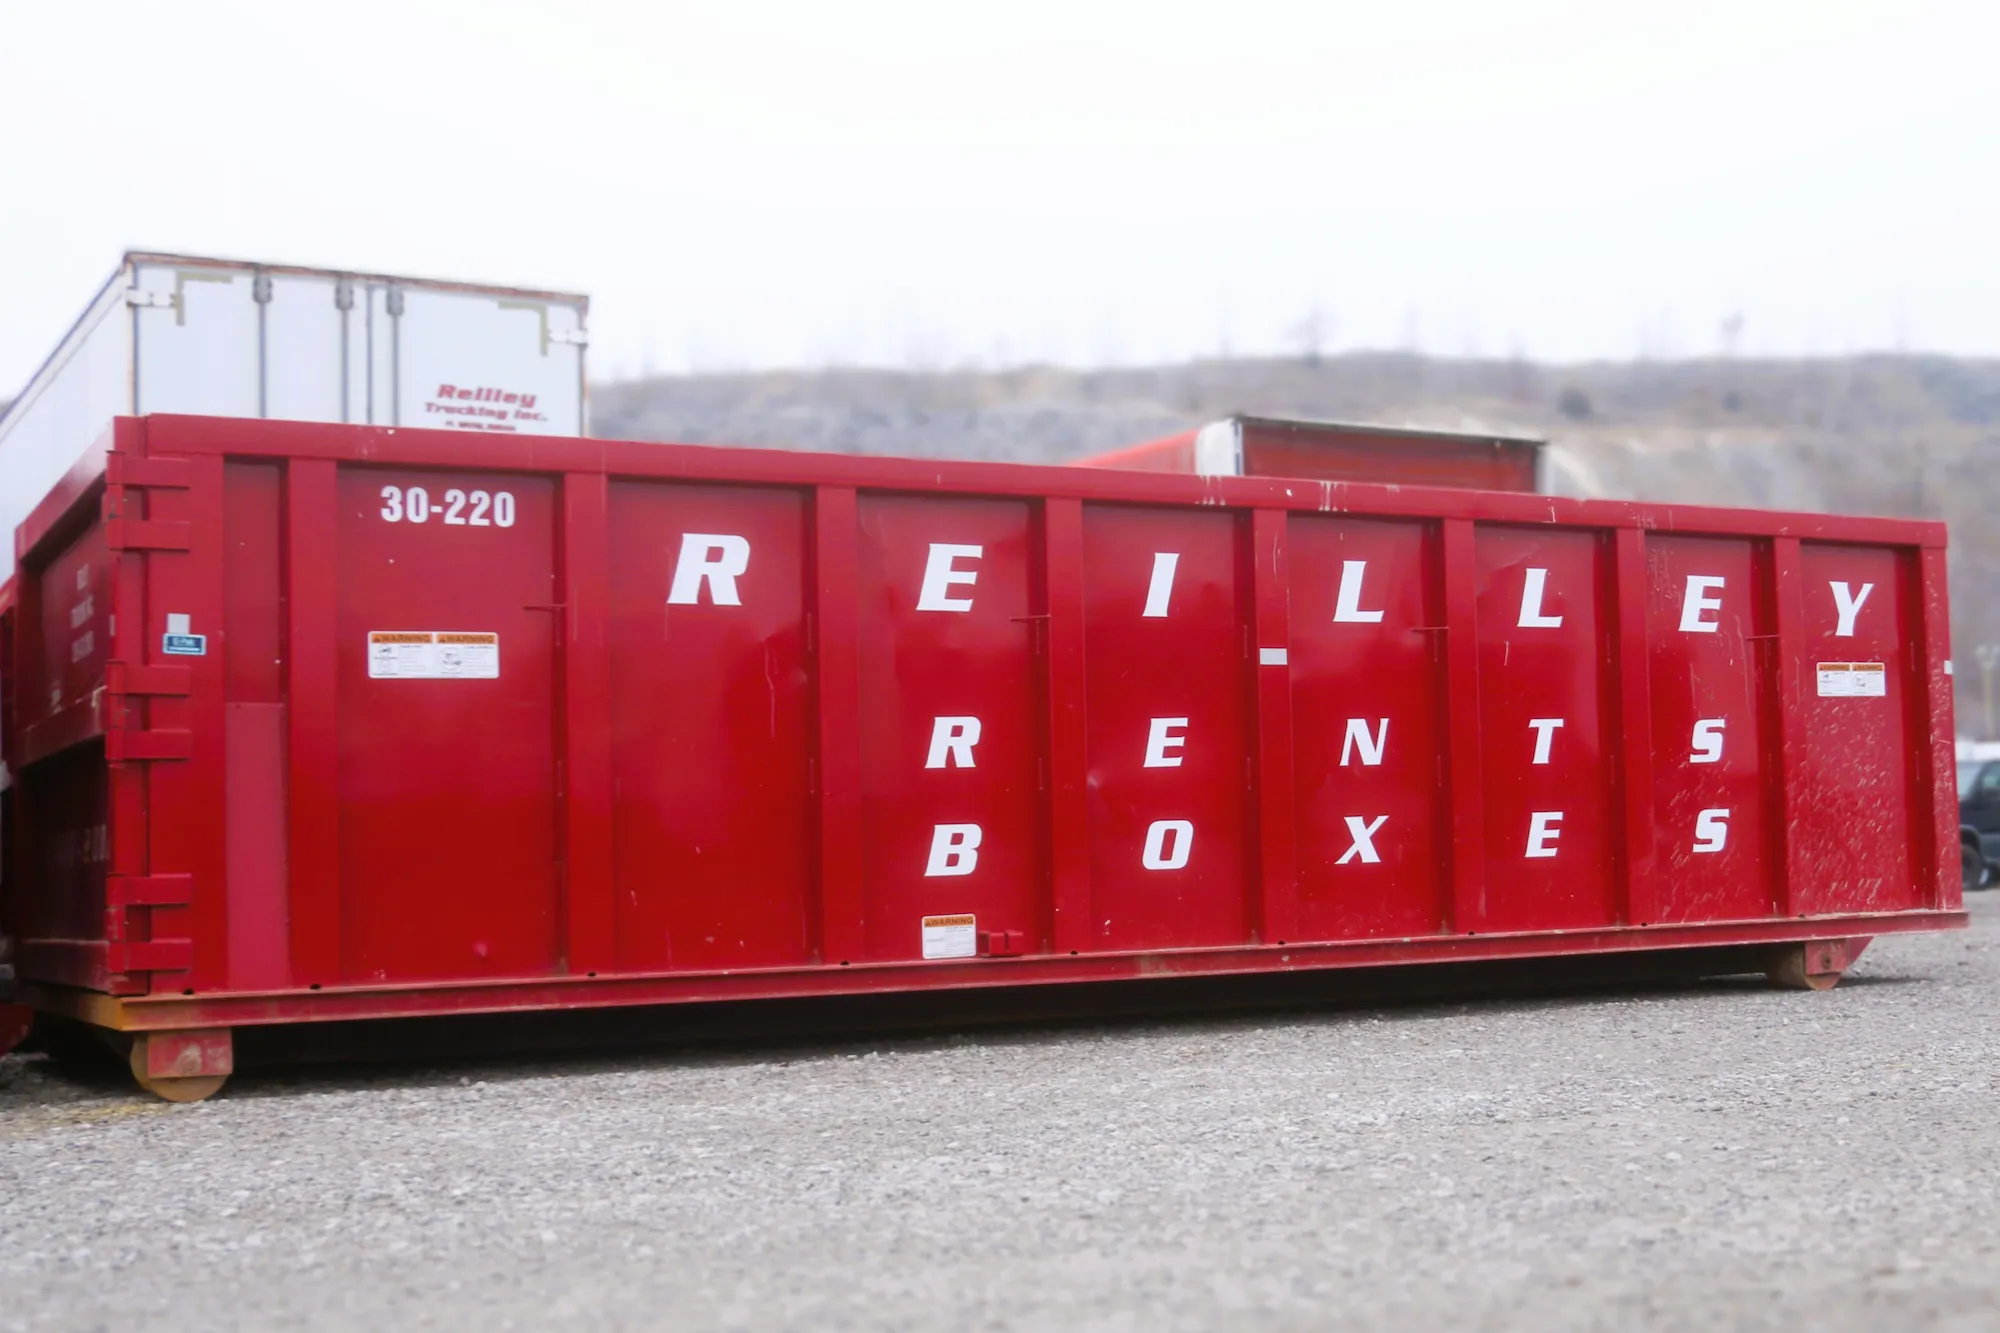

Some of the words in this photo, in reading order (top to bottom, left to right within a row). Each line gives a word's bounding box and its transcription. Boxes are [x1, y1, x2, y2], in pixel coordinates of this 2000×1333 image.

[437, 384, 537, 408] Reilley
[425, 401, 508, 420] Trucking
[380, 485, 516, 528] 30-220
[930, 916, 973, 925] WARNING
